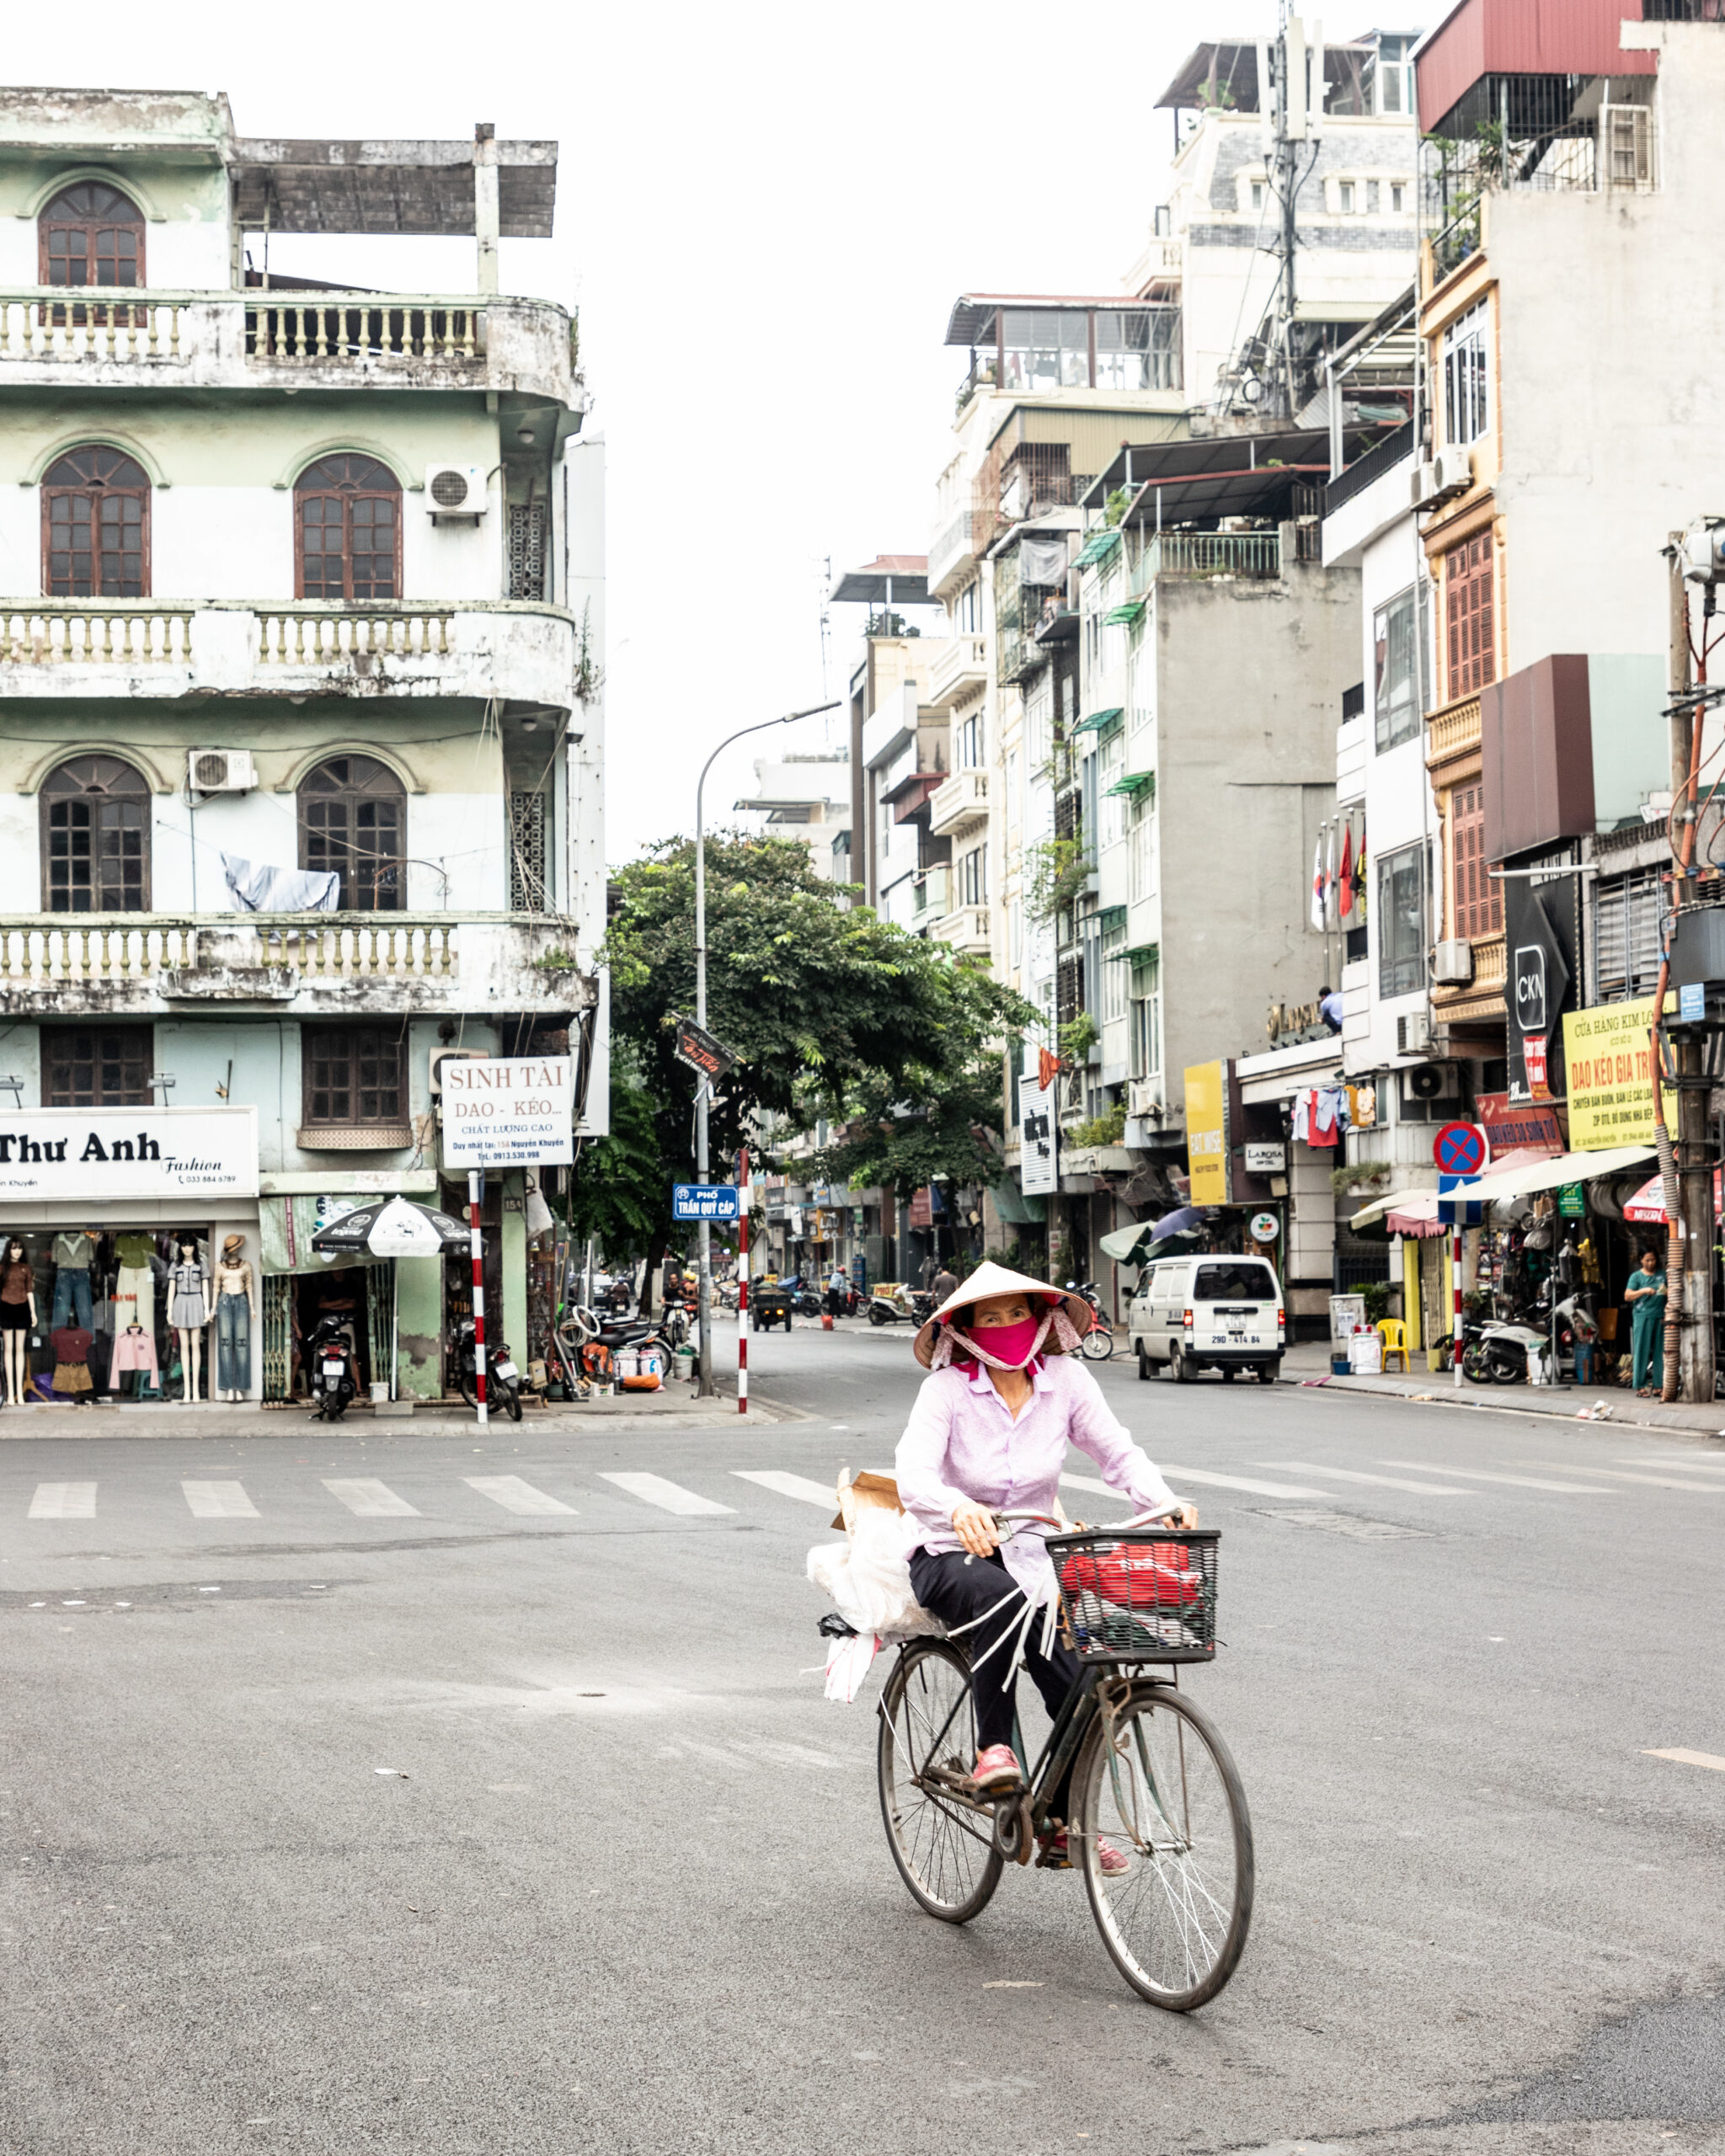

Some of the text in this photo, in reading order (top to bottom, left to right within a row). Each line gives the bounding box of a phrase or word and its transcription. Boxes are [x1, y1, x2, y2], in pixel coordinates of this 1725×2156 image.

[1518, 973, 1543, 1003] CKN
[1621, 1012, 1639, 1029] KIM
[450, 1060, 563, 1090] SINH TÀI
[1572, 1060, 1591, 1091] DAO
[1594, 1050, 1613, 1087] KÉO
[1616, 1053, 1633, 1083] GIA
[455, 1102, 494, 1118] DAO
[462, 1123, 553, 1134] CHẤT LƯỢNG CAO
[79, 1132, 162, 1161] Anh
[453, 1142, 466, 1150] Duy
[161, 1156, 222, 1174] Fashion
[186, 1175, 200, 1183] 033
[697, 1188, 718, 1199] PHỐ
[701, 1199, 717, 1215] QUÝ
[718, 1199, 735, 1215] CÁP
[1234, 1335, 1247, 1344] 414
